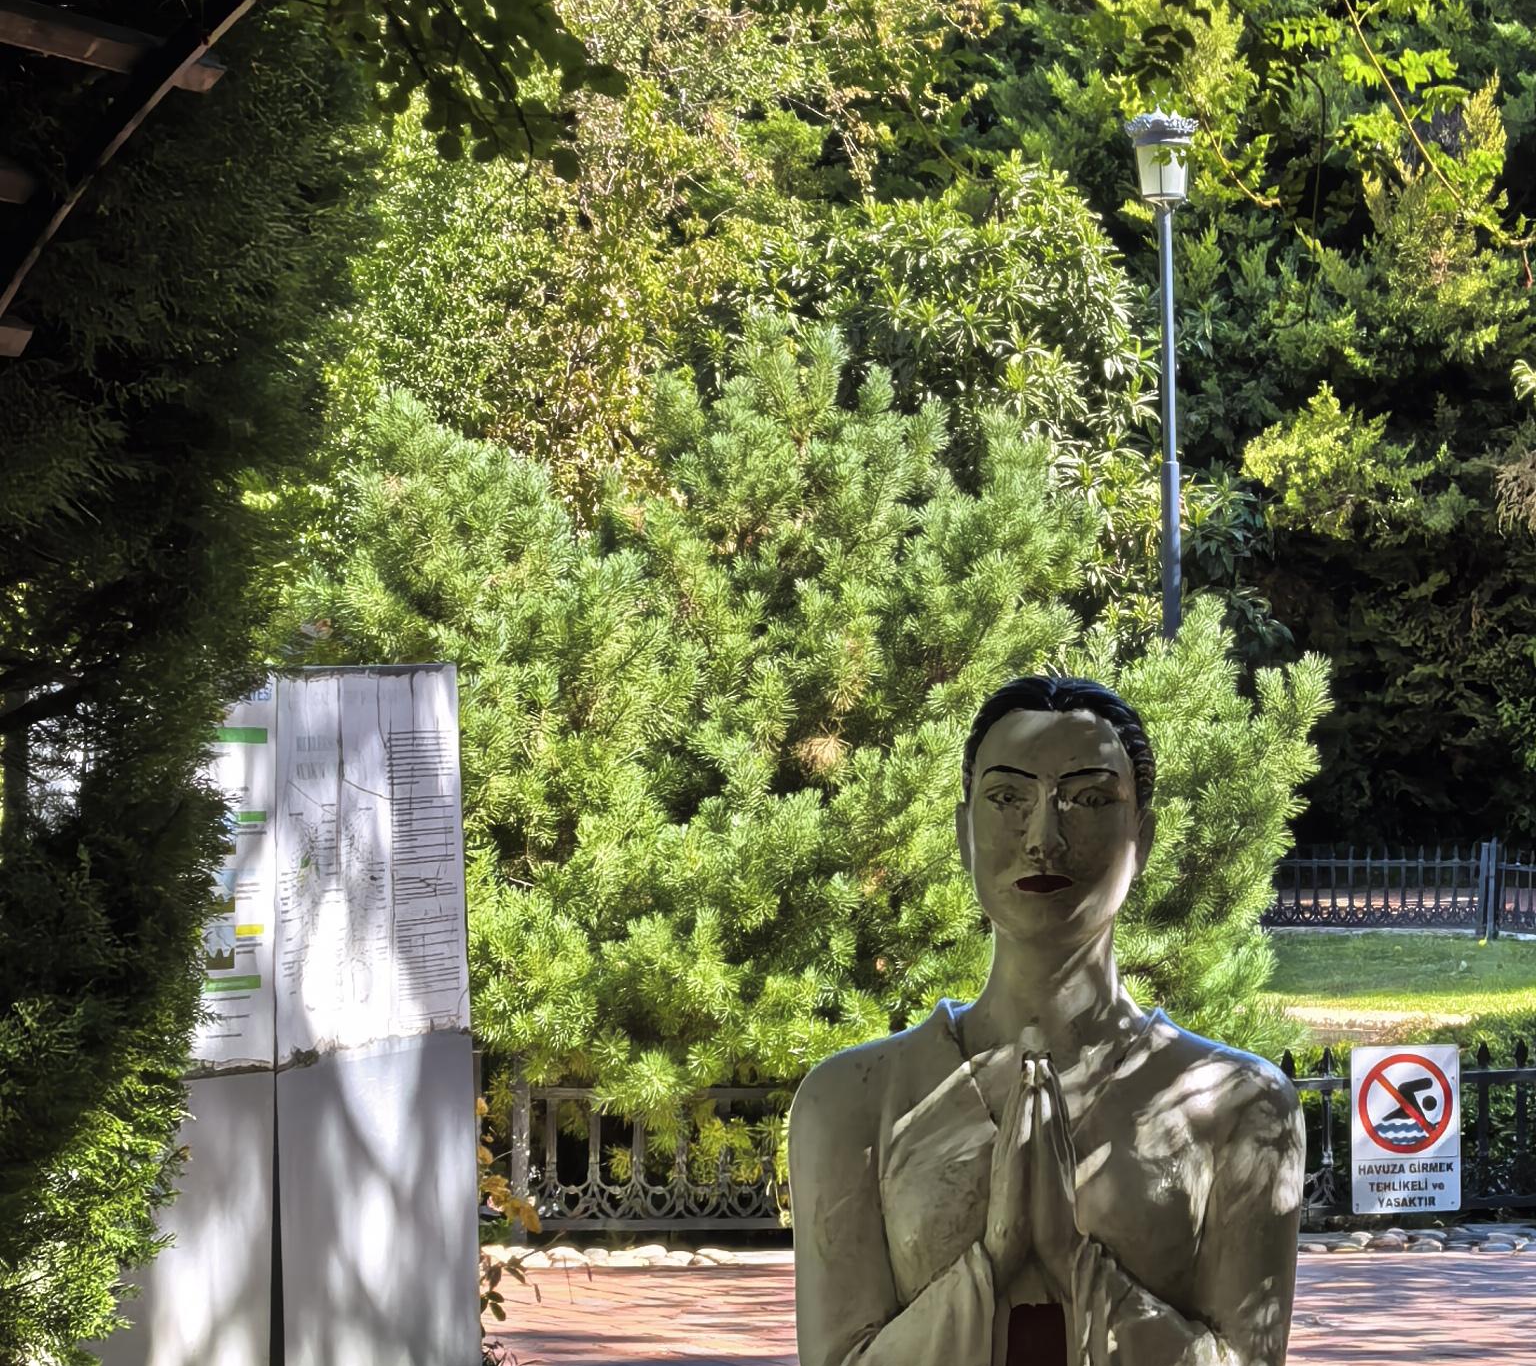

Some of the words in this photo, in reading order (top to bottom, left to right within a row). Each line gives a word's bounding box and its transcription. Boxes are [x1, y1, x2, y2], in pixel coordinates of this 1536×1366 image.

[1358, 1163, 1406, 1175] HAVUZA
[1409, 1160, 1454, 1173] GİRMEK
[1432, 1182, 1445, 1191] ve
[1377, 1195, 1436, 1208] YASAKTIR
